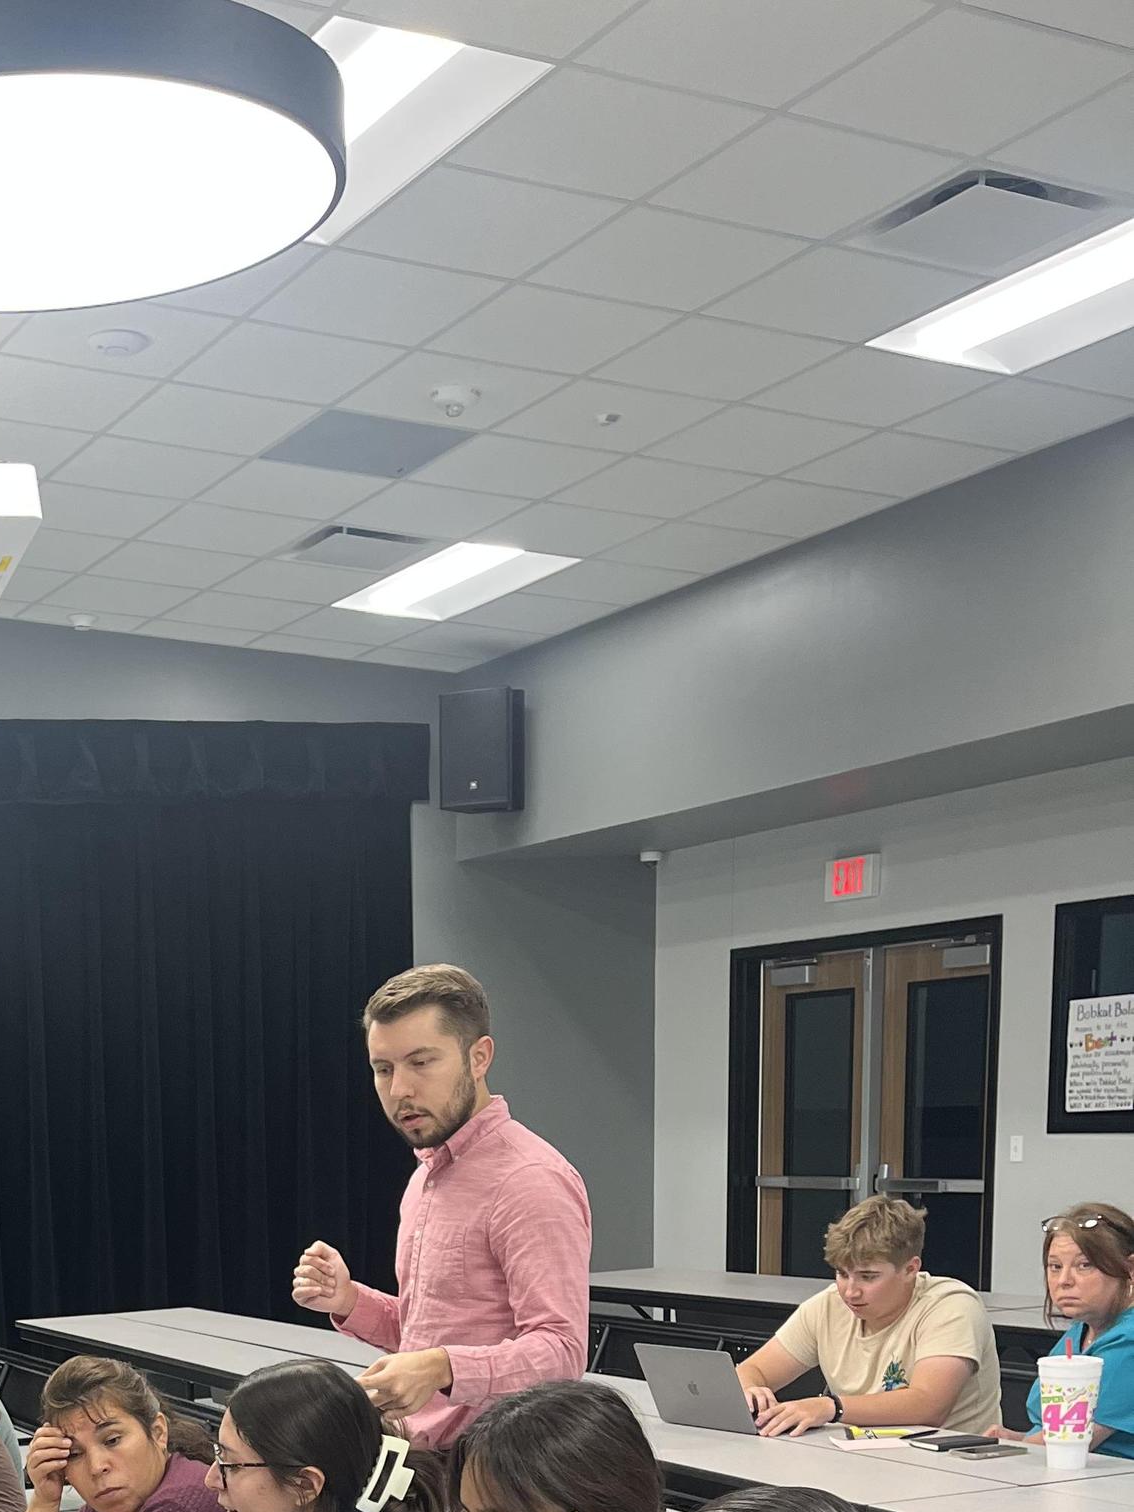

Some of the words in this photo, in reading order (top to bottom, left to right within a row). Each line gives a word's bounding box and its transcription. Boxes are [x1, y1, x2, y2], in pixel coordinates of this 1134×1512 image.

[833, 856, 866, 896] EXIT
[1076, 1003, 1112, 1021] Bobkat
[1043, 1401, 1088, 1432] 44
